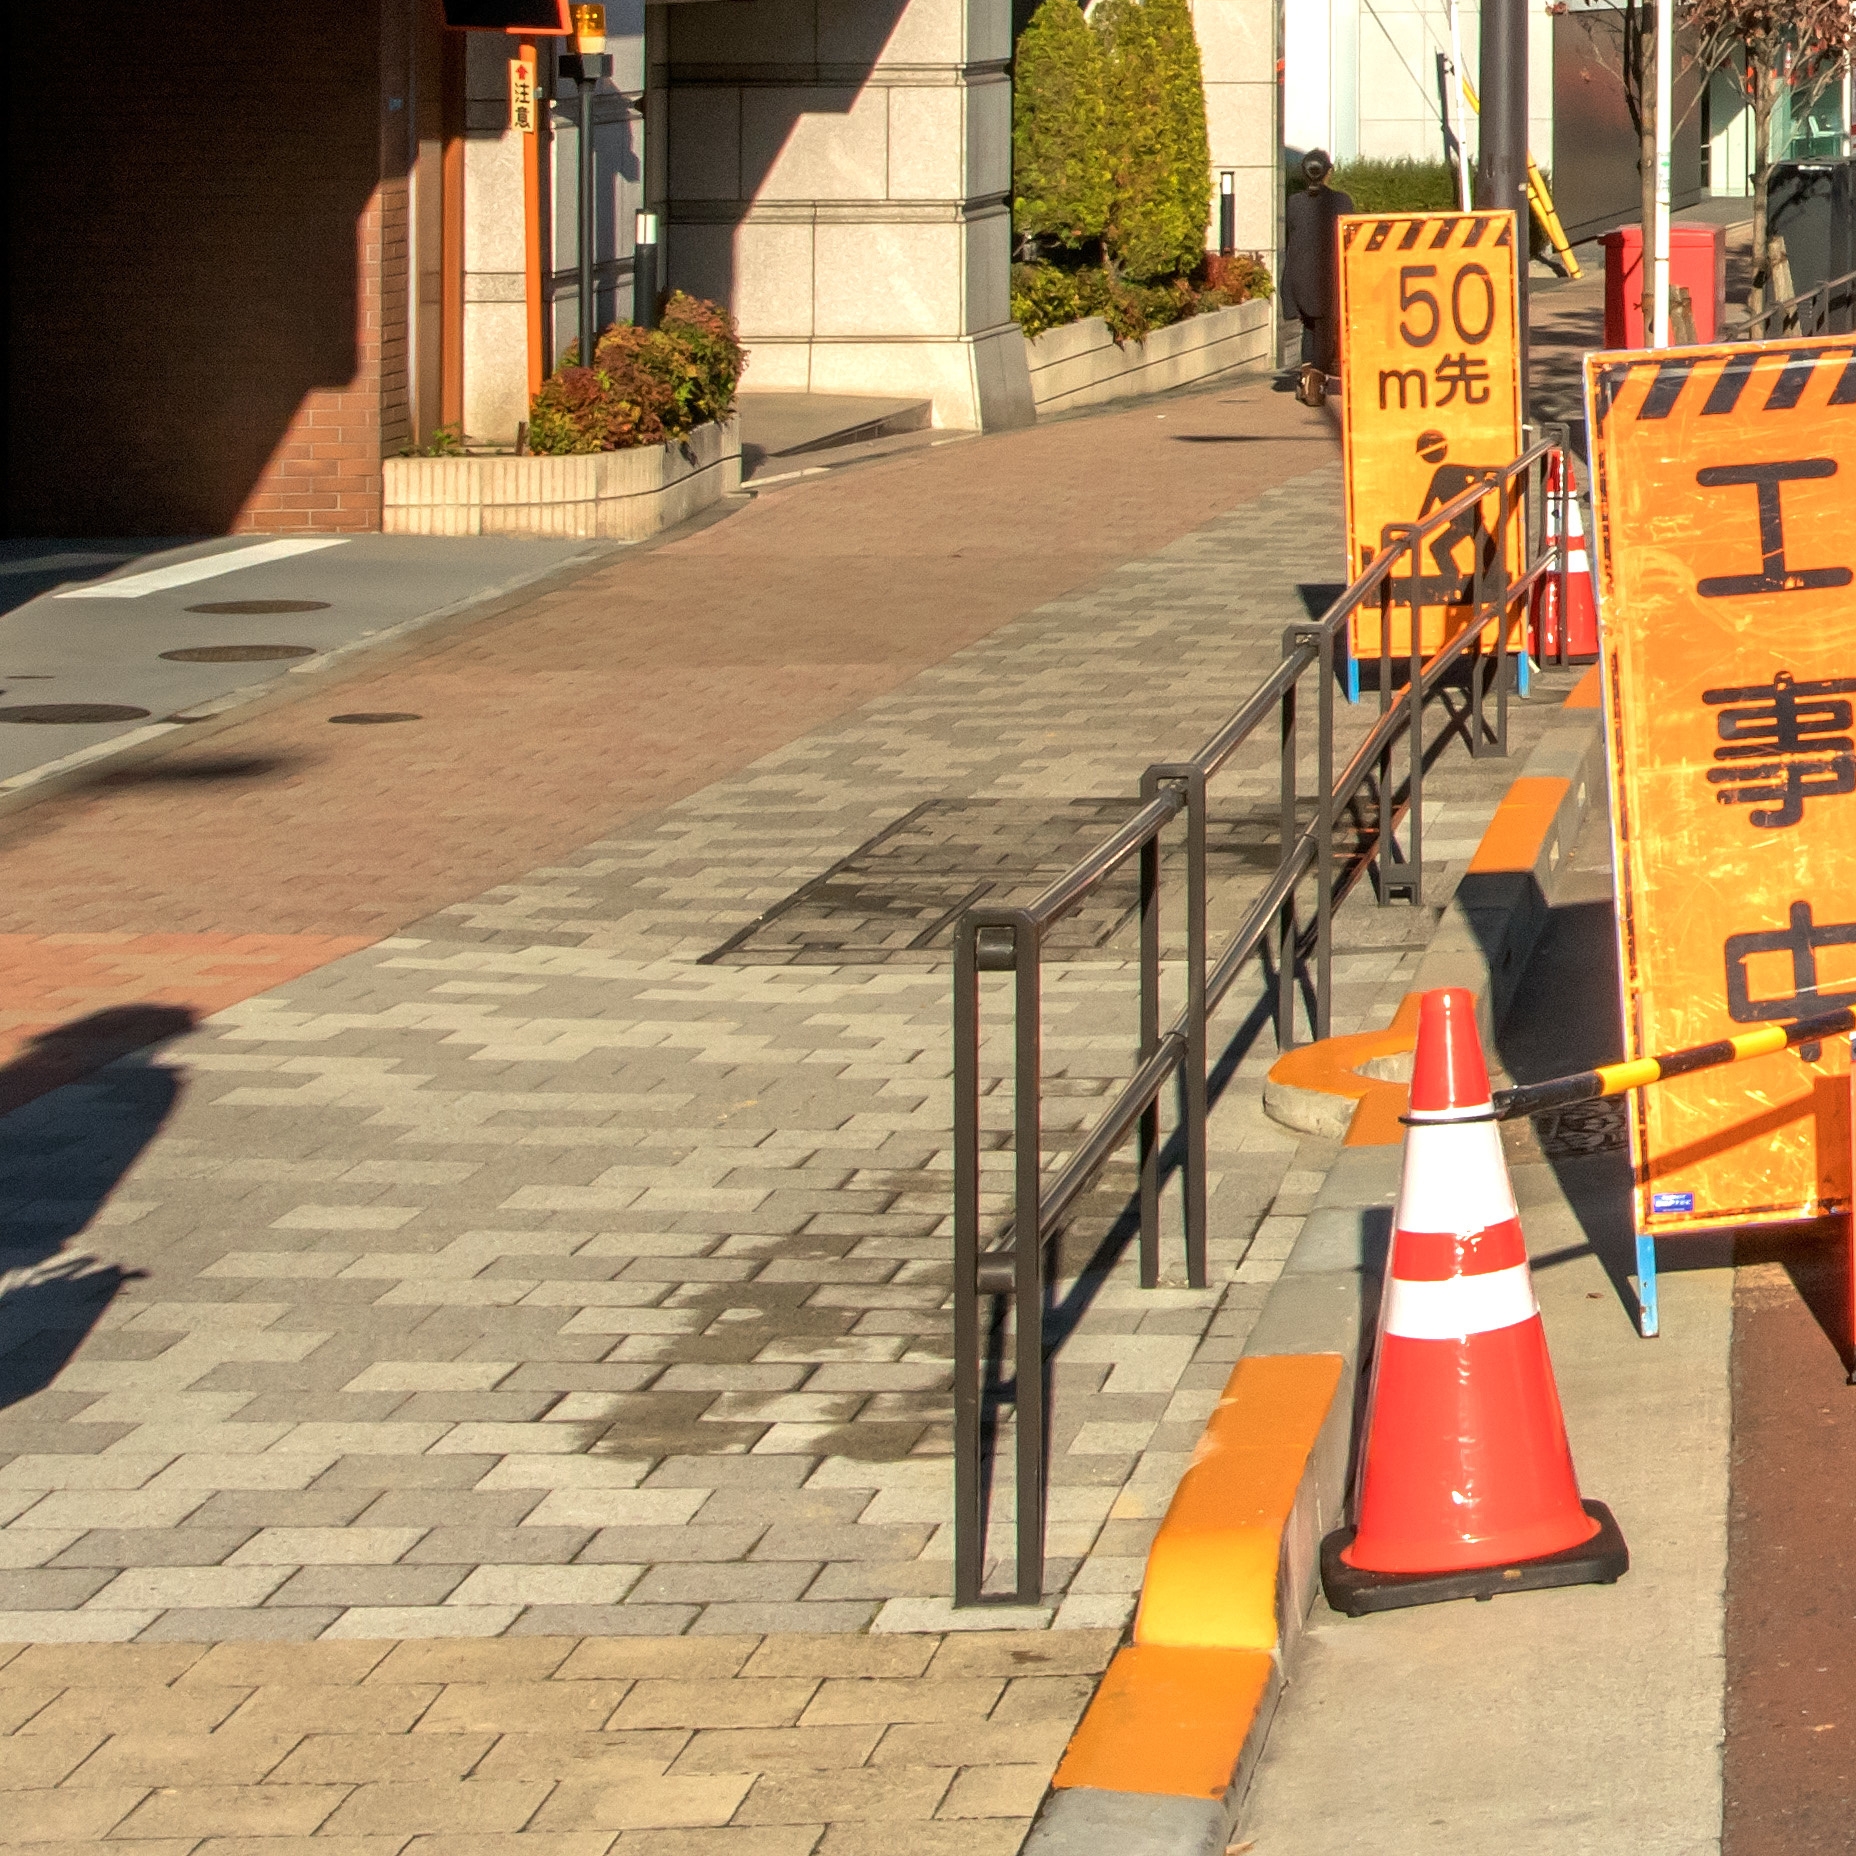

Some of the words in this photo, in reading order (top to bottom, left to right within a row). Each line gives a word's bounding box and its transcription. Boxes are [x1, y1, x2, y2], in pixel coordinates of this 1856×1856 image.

[515, 83, 530, 128] 注意
[1399, 263, 1495, 349] 50
[1380, 355, 1491, 410] m先
